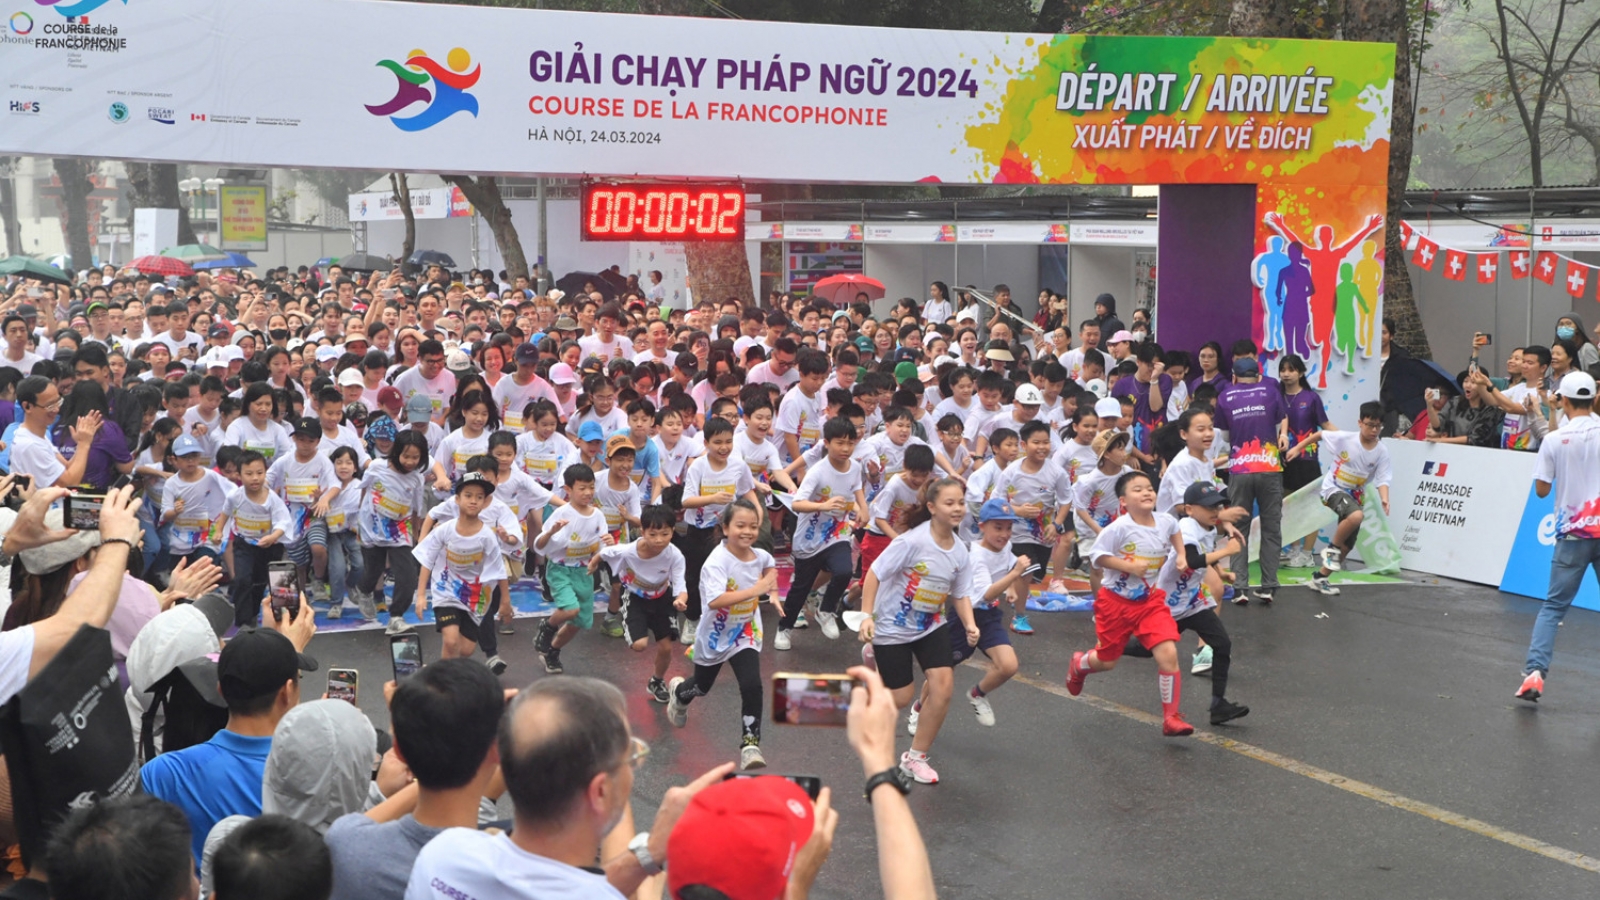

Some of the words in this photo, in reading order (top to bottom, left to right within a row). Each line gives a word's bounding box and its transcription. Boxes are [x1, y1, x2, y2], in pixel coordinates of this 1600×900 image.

[35, 38, 127, 49] FRANCOPHONIE
[529, 41, 603, 85] GIẢI
[611, 53, 707, 97] CHẠY
[716, 54, 811, 93] PHÁP
[819, 58, 891, 96] NGỮ
[896, 66, 978, 98] 2024
[1056, 63, 1177, 111] DÉPART
[1181, 74, 1202, 111] /
[1205, 66, 1333, 114] ARRIVÉE
[528, 95, 625, 118] COURSE
[633, 98, 663, 118] DE
[671, 100, 700, 120] LA
[706, 102, 888, 126] FRANCOPHONIE
[528, 126, 548, 141] HÀ
[553, 127, 587, 146] NỘI,
[590, 130, 662, 144] 24.03.2024
[1071, 118, 1137, 149] XUẤT
[1139, 121, 1202, 149] PHÁT
[1223, 117, 1255, 150] VỀ
[1258, 121, 1312, 150] ĐÍCH
[589, 191, 741, 234] 00:00:02
[1417, 480, 1473, 498] AMBASSADE
[1413, 494, 1425, 507] DE
[1427, 496, 1464, 512] FRANCE
[1408, 509, 1423, 521] AU
[1424, 511, 1466, 528] VIETNAM
